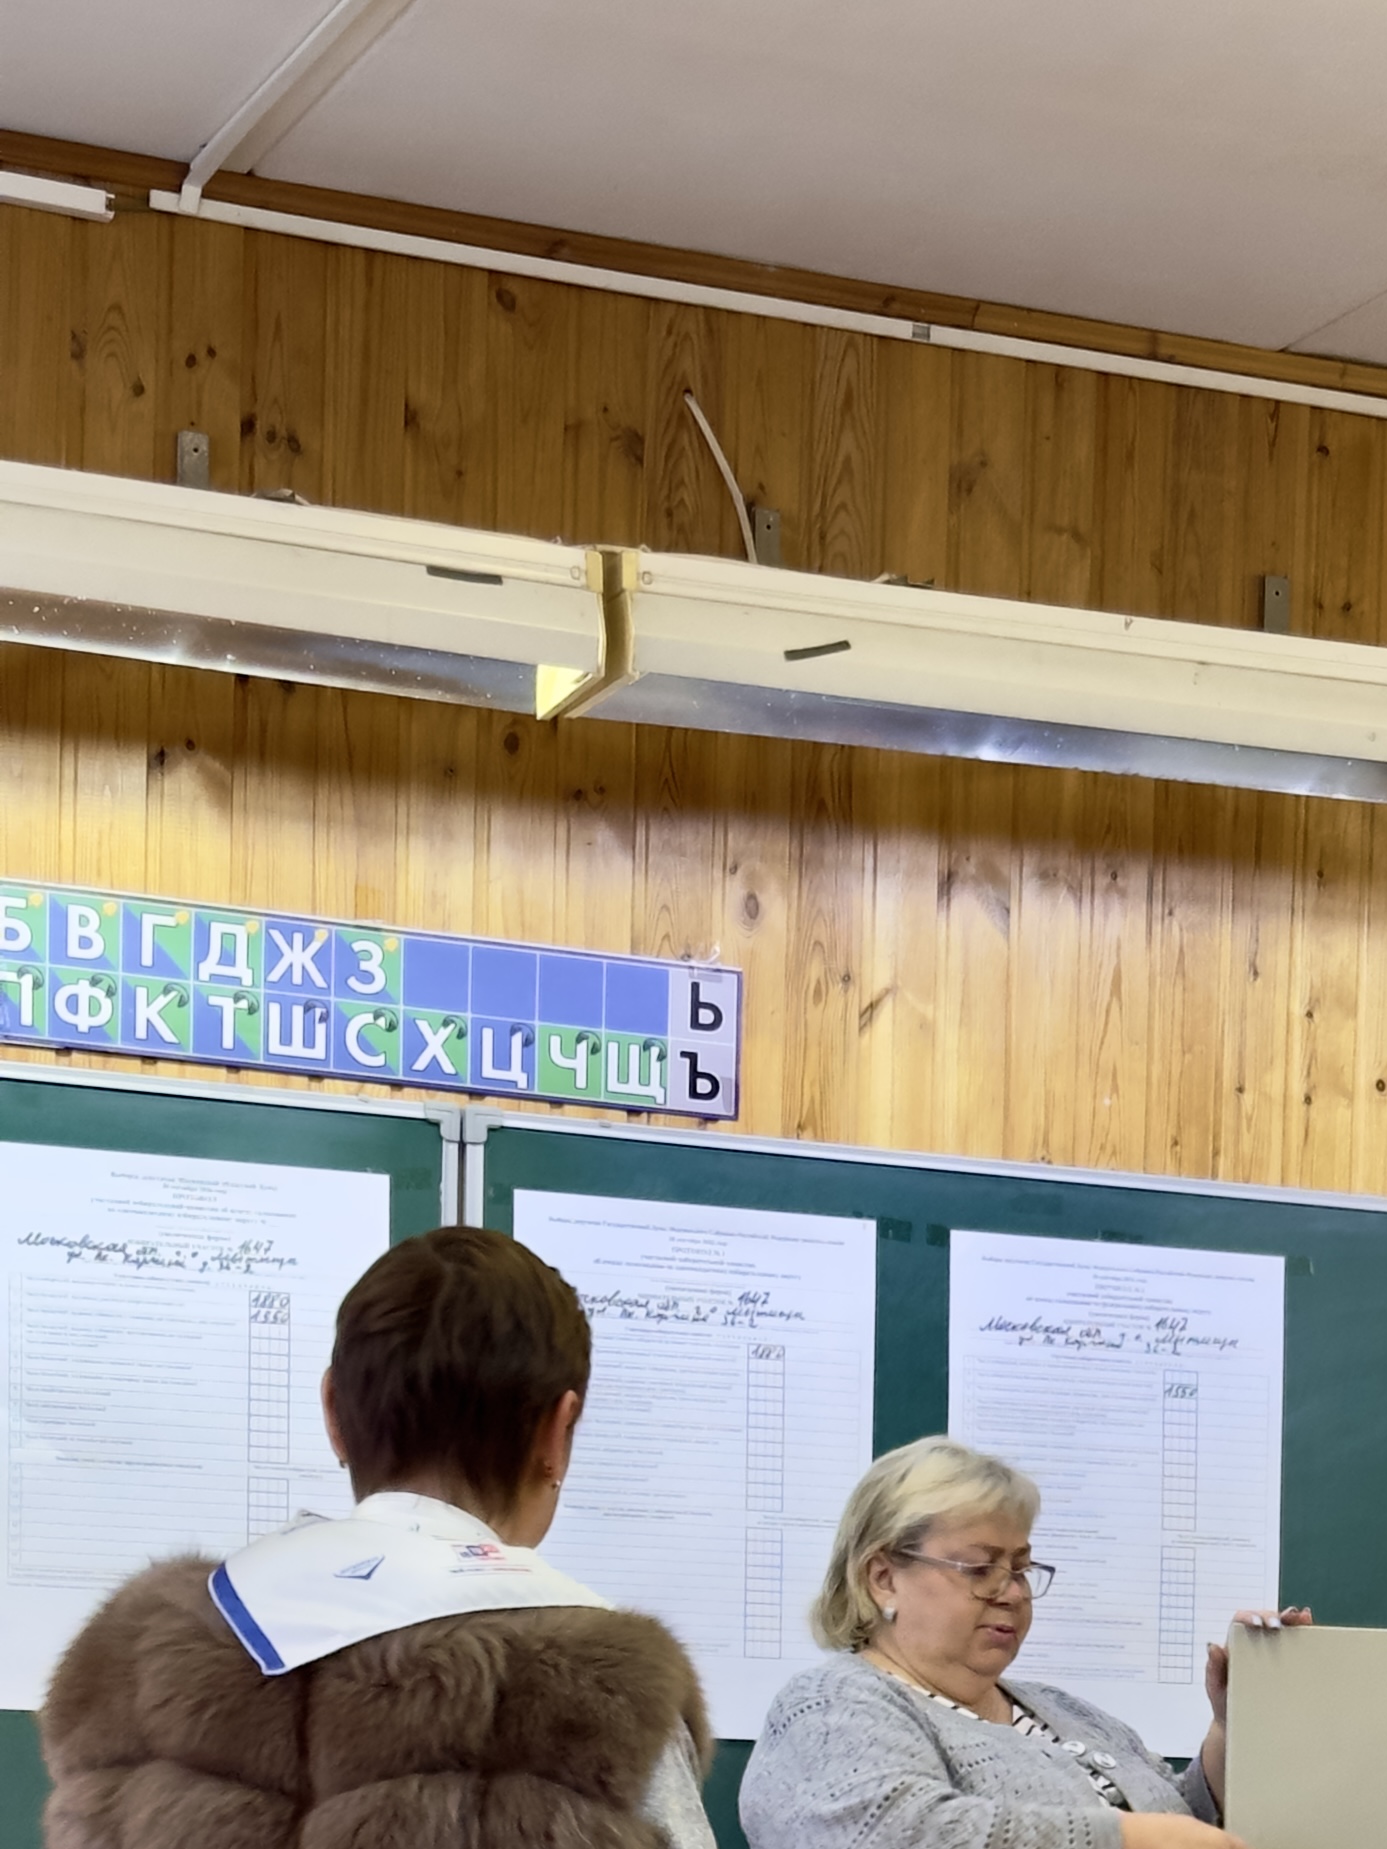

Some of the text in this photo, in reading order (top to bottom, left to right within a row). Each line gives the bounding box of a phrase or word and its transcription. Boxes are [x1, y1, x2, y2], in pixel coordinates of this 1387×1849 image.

[65, 903, 105, 960] В
[140, 912, 180, 968] Г
[199, 920, 253, 987] Д
[266, 928, 328, 990] Ж
[346, 939, 388, 995] З
[690, 981, 723, 1031] Ь
[54, 978, 113, 1034] Ф
[134, 985, 181, 1045] К
[207, 994, 250, 1050] Т
[268, 1001, 326, 1061] Ш
[344, 1012, 387, 1069] С
[411, 1018, 457, 1076] Х
[481, 1026, 528, 1090] Ц
[549, 1033, 588, 1090] Ч
[607, 1040, 667, 1106] Щ
[679, 1050, 721, 1102] Ъ
